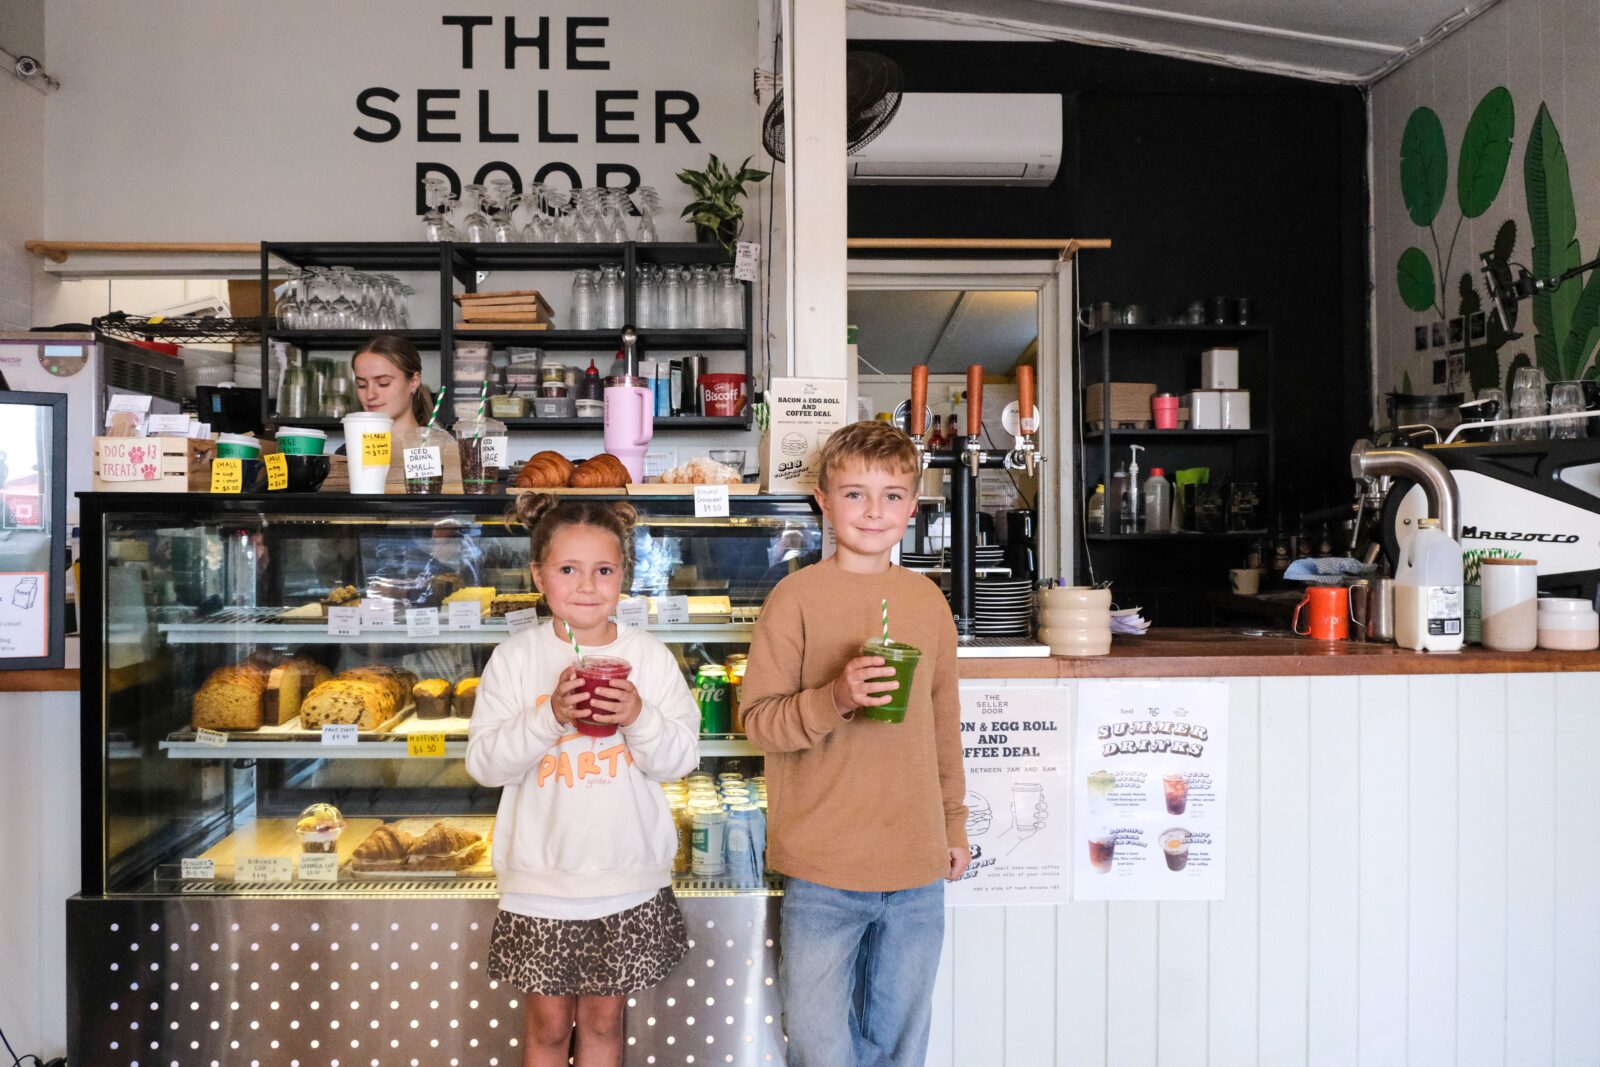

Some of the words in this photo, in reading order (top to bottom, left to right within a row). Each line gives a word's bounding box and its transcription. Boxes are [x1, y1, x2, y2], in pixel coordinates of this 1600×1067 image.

[442, 15, 610, 70] THE
[353, 87, 702, 144] SELLER
[416, 161, 643, 217] DOOR
[705, 389, 739, 402] Biscoff
[104, 444, 125, 458] DOG
[410, 448, 428, 456] ICED
[409, 454, 434, 462] DRINK
[103, 463, 137, 477] TREATS
[216, 461, 237, 469] SMALL
[406, 463, 435, 473] SMALL
[703, 504, 722, 512] $9.50
[1148, 707, 1160, 717] TLC
[979, 722, 988, 732] &
[991, 721, 1019, 732] EGG
[1022, 721, 1057, 731] ROLL
[1097, 720, 1208, 741] SUMMER
[408, 734, 445, 743] MUFFINS!
[977, 734, 1008, 745] AND
[962, 747, 999, 758] FFEE
[1002, 746, 1040, 758] DEAL
[1102, 739, 1204, 758] DRINKS
